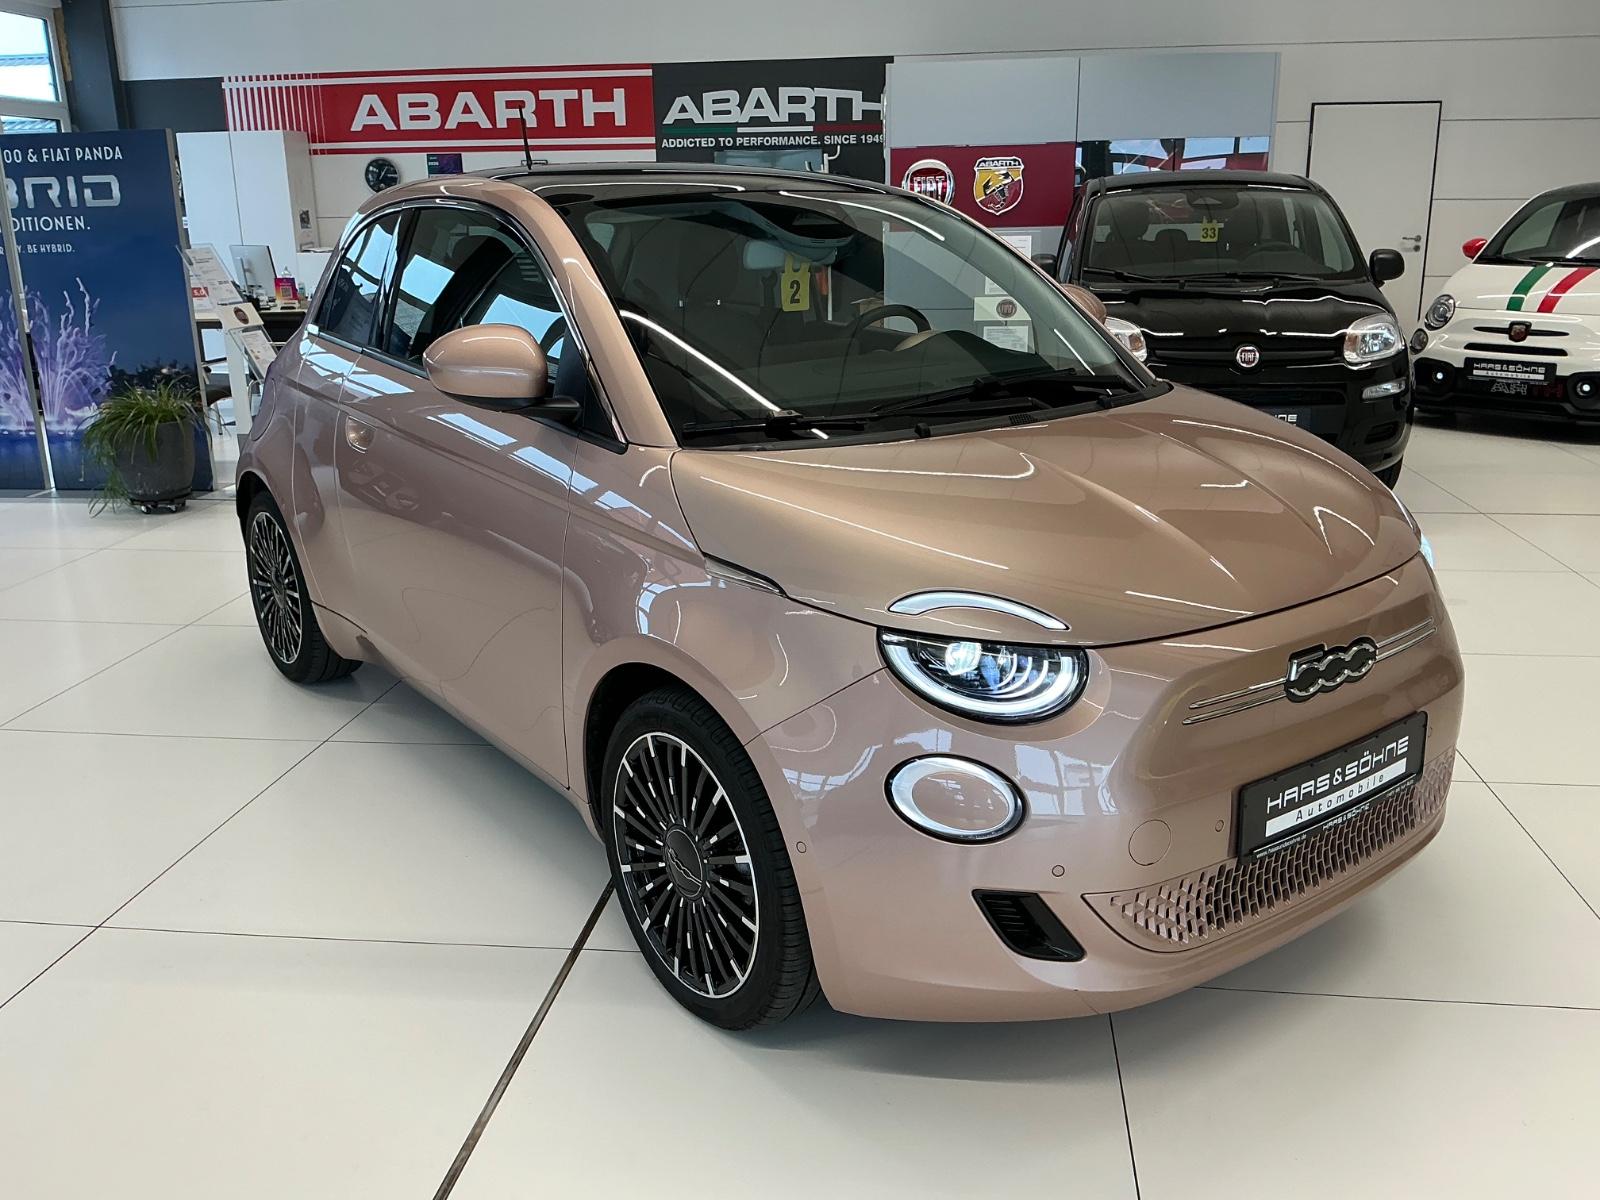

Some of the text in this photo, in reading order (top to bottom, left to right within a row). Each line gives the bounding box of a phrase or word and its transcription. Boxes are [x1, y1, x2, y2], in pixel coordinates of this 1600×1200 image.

[350, 87, 627, 132] ABARTH
[662, 86, 883, 125] ABARTH
[661, 133, 884, 148] ADDICTED TO PERFORMANCE. SINCE 1949
[3, 146, 122, 163] 00 & FIAT PANDA
[913, 175, 945, 200] FIAT
[12, 216, 91, 232] DITIONEN.
[1201, 227, 1216, 239] 33
[27, 245, 38, 253] BE
[40, 244, 75, 253] HYBRID.
[790, 280, 801, 304] 2
[1241, 352, 1255, 362] FIAT
[1286, 638, 1378, 702] 500
[1295, 774, 1385, 822] Automobile
